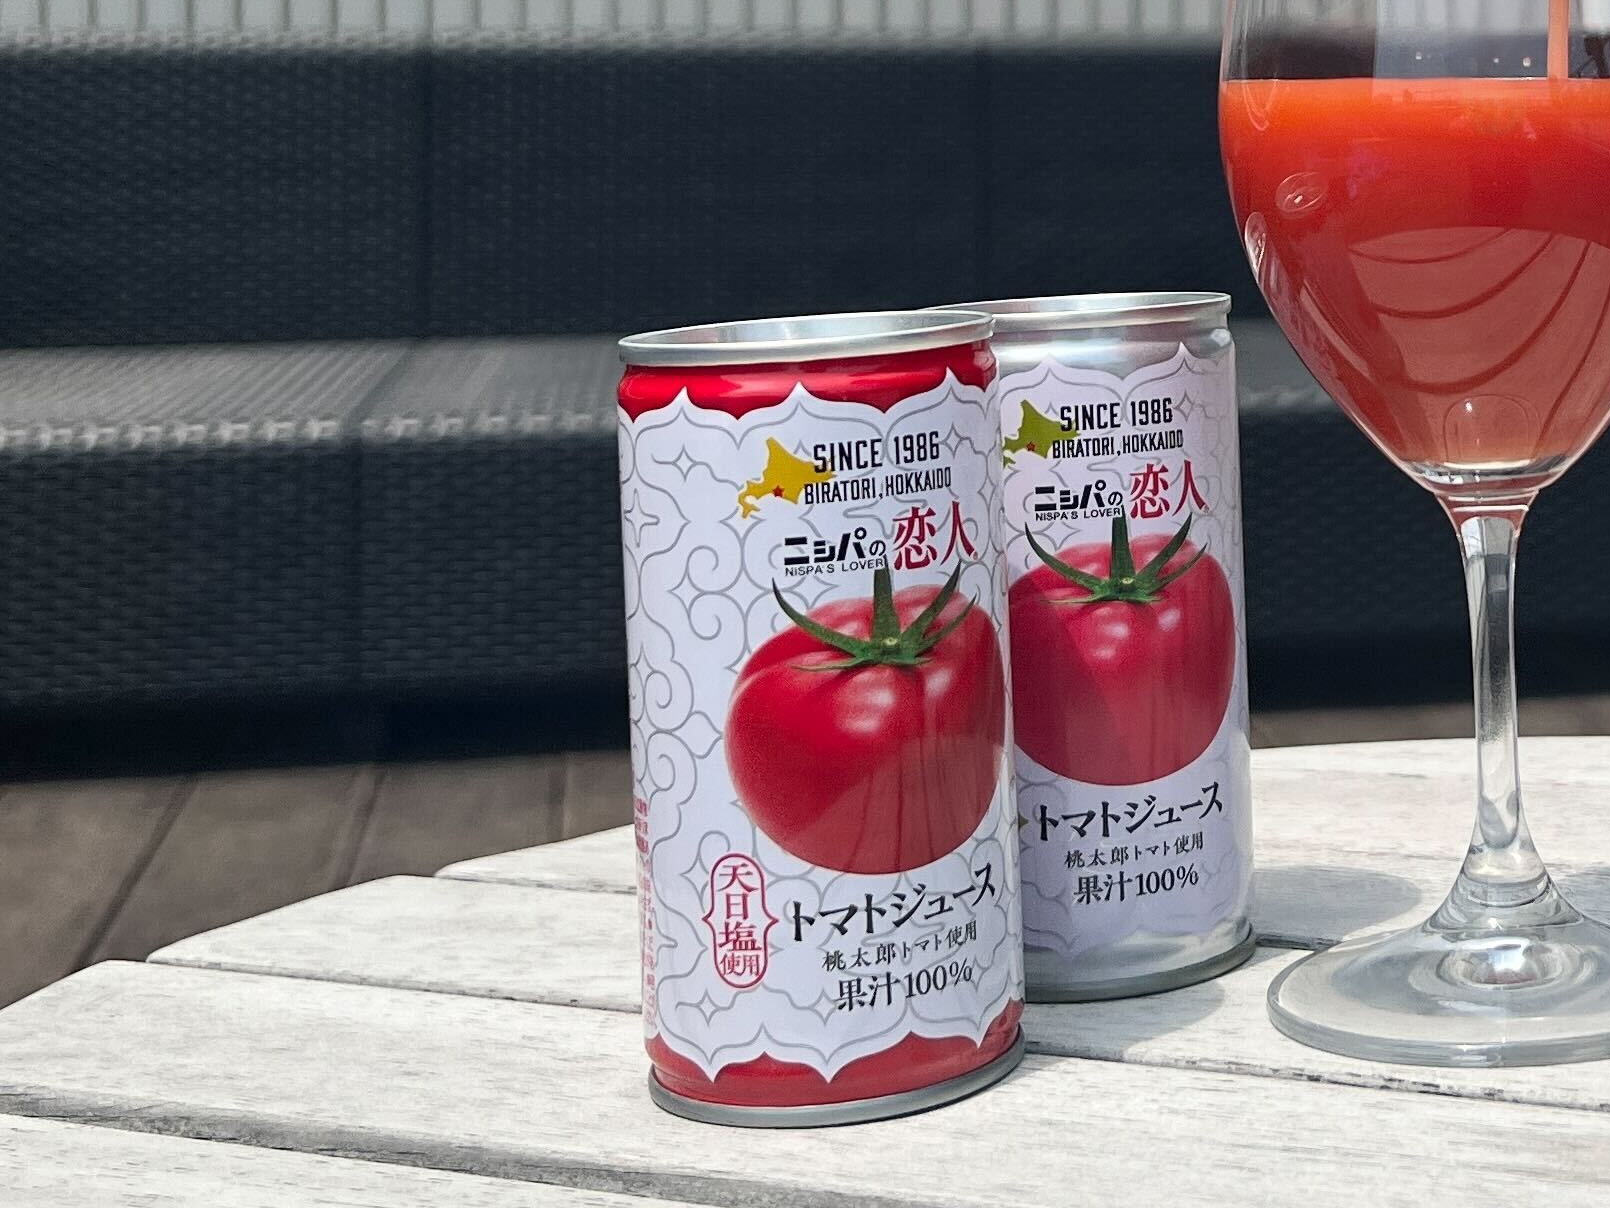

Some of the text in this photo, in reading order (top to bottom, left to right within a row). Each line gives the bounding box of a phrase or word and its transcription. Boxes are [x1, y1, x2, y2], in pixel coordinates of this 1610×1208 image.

[1060, 397, 1174, 432] SINCE 1986
[813, 430, 940, 474] SINCE 1986
[1035, 507, 1121, 521] NISPA'S LOVER
[841, 558, 885, 573] LOVER
[1039, 781, 1223, 841] トマトジュース
[792, 862, 997, 942] トマトジュース
[1073, 863, 1200, 905] 果汁100%
[835, 957, 974, 1012] 果汁100%
